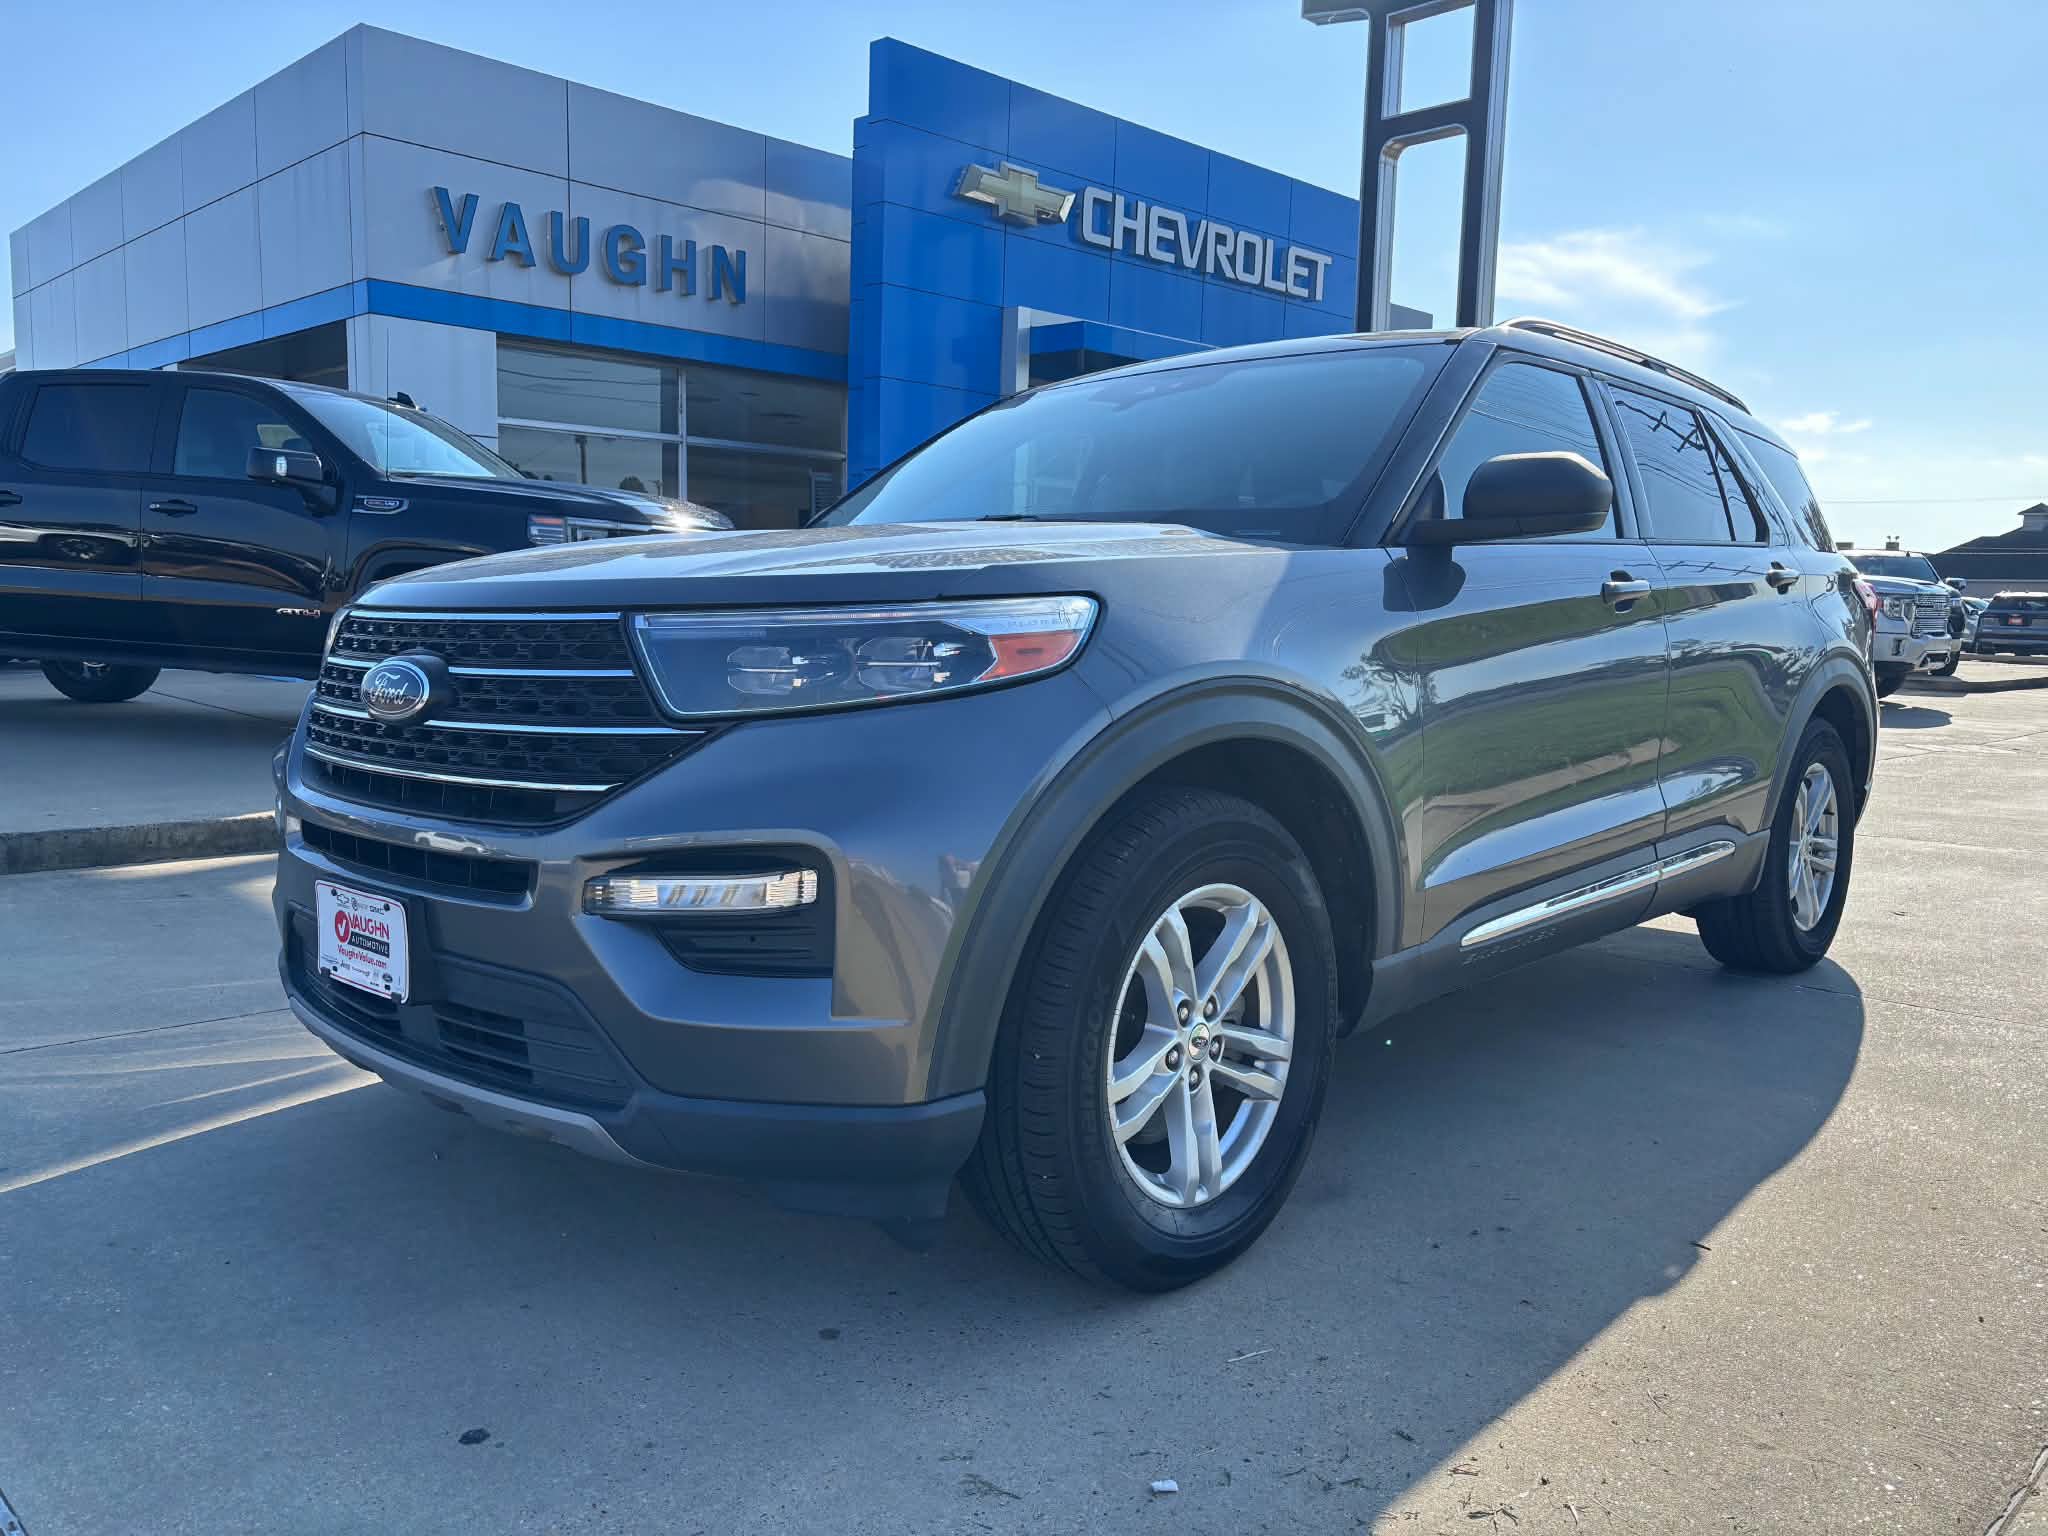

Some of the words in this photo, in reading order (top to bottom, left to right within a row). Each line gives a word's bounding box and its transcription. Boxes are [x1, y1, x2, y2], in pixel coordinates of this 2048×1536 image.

[431, 186, 746, 304] VAUGHN
[1081, 186, 1333, 302] CHEVROLET
[368, 671, 414, 705] Ford
[348, 911, 390, 941] VAUGHN
[351, 935, 389, 955] AUTOMOTIVE
